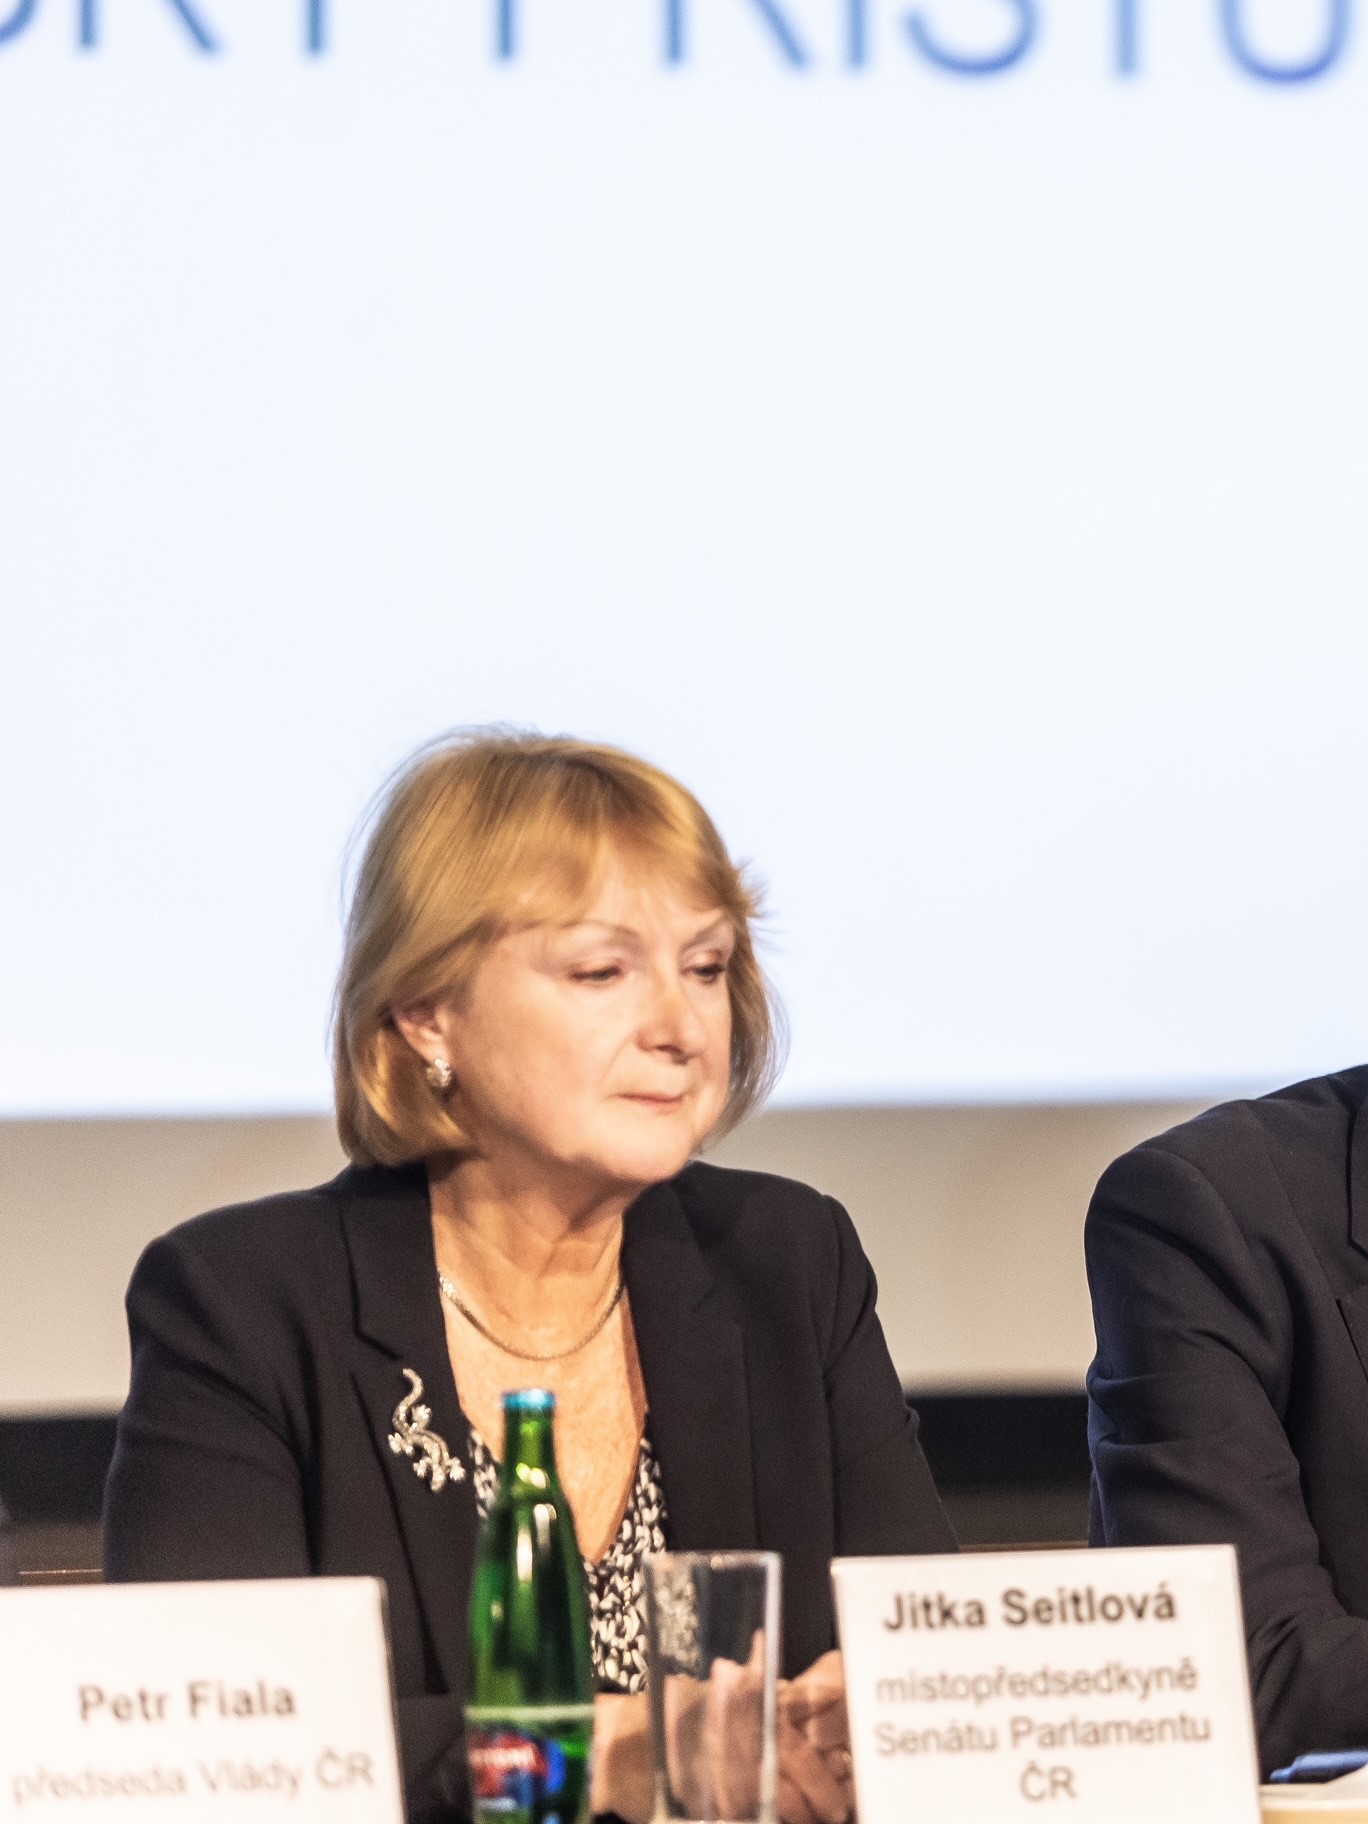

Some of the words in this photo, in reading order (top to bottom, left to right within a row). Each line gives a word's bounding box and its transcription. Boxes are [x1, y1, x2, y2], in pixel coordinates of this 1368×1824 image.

[884, 1591, 987, 1632] Jitka
[1001, 1582, 1178, 1628] Seitlová
[77, 1683, 168, 1723] Petr
[187, 1679, 298, 1720] Fiala
[874, 1718, 999, 1759] Senátu
[1009, 1710, 1212, 1751] Parlamentu
[314, 1746, 377, 1792] ČR
[1017, 1759, 1079, 1803] ČR
